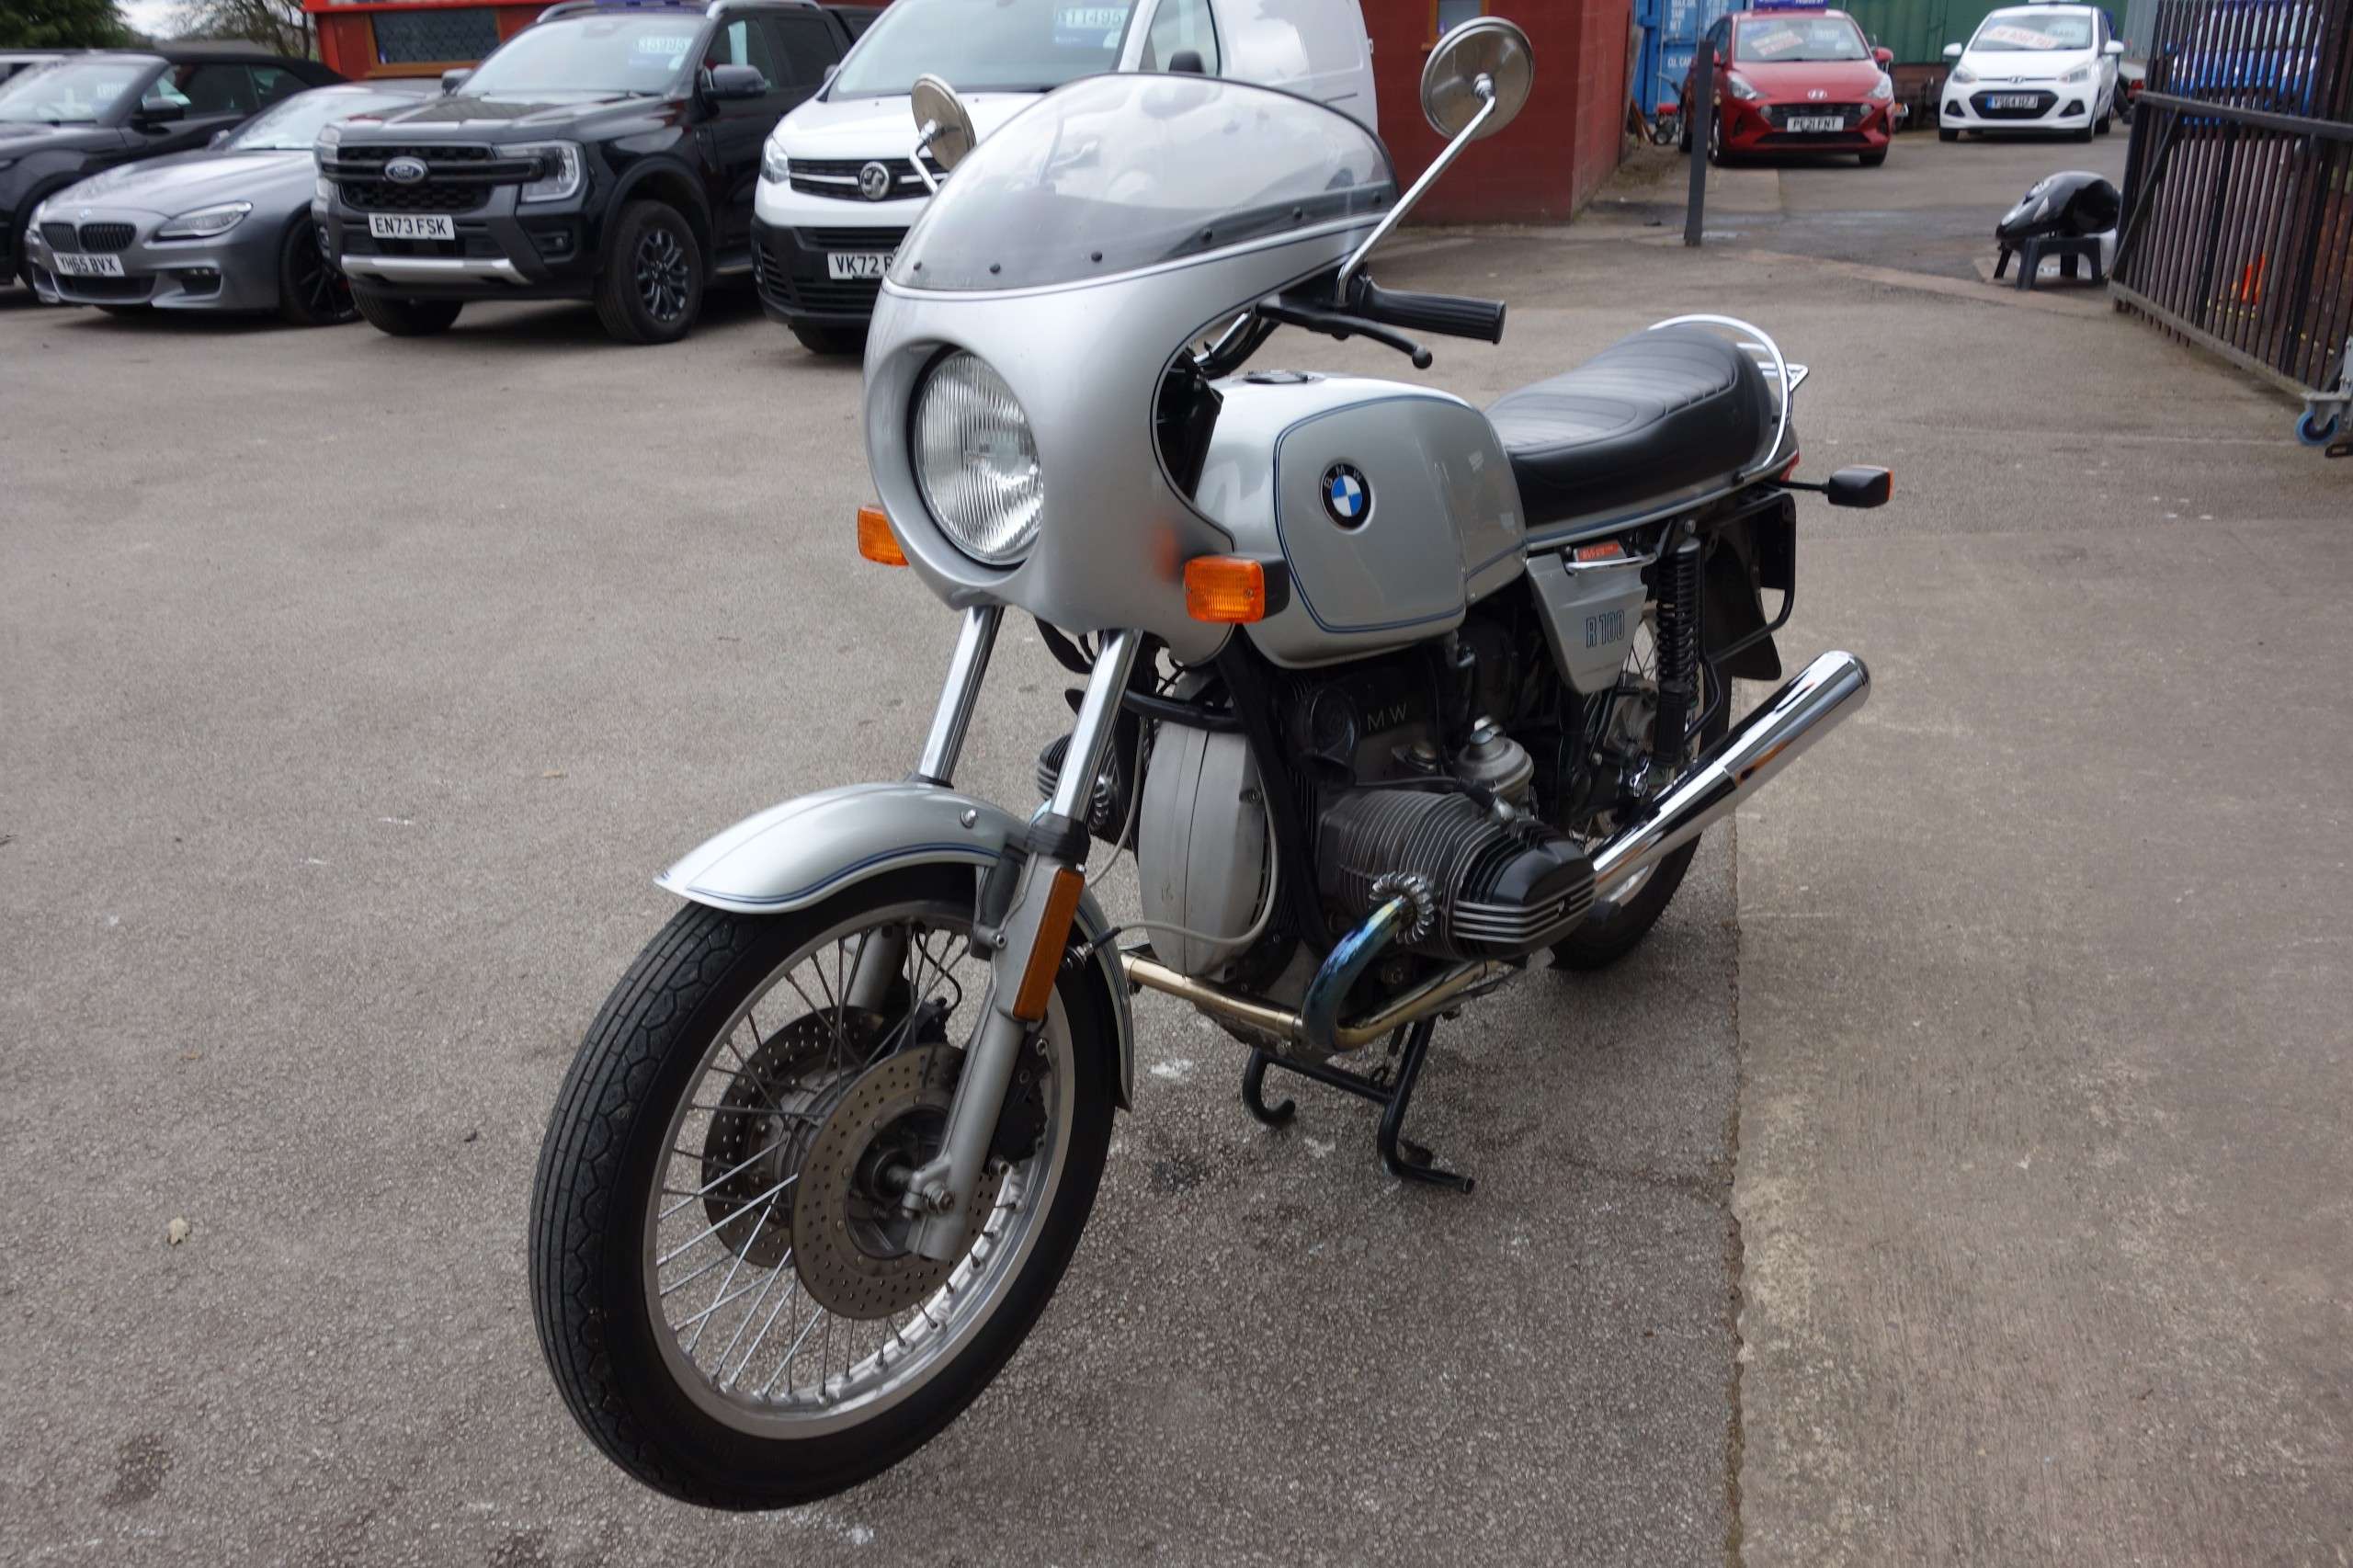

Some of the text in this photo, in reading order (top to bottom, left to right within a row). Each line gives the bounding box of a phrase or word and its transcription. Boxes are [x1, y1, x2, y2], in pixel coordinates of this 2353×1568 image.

[375, 217, 447, 235] EN73 FSK
[835, 256, 879, 274] VK72
[1324, 465, 1362, 489] BMW
[1367, 701, 1407, 732] MW
